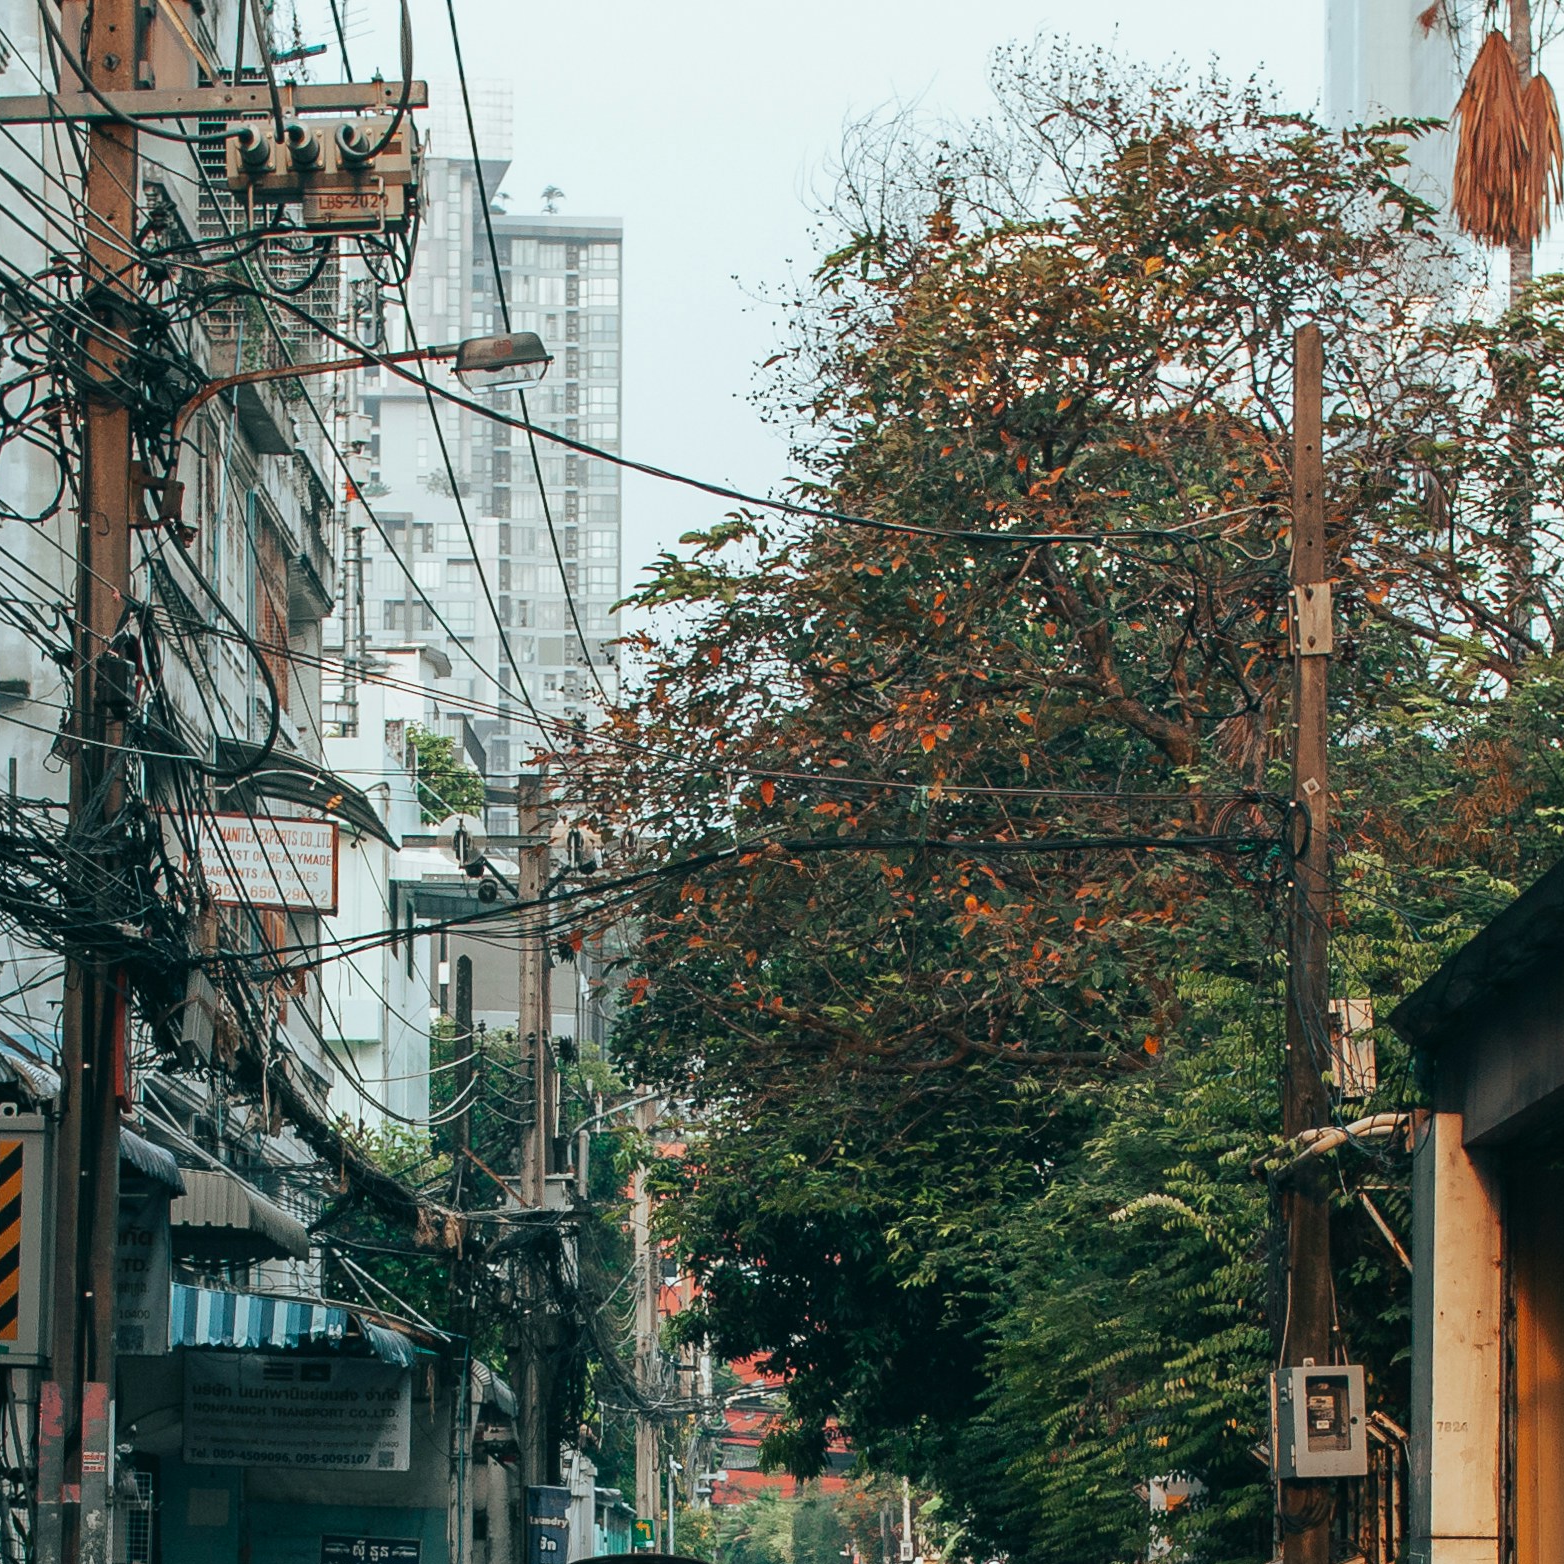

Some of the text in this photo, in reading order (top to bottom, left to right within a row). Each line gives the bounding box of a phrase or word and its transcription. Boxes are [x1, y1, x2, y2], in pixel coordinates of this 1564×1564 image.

[192, 1403, 266, 1417] NONPANICH
[270, 1405, 345, 1418] TRANSPORT
[190, 1447, 209, 1458] Tel.
[529, 1515, 568, 1529] Laundry
